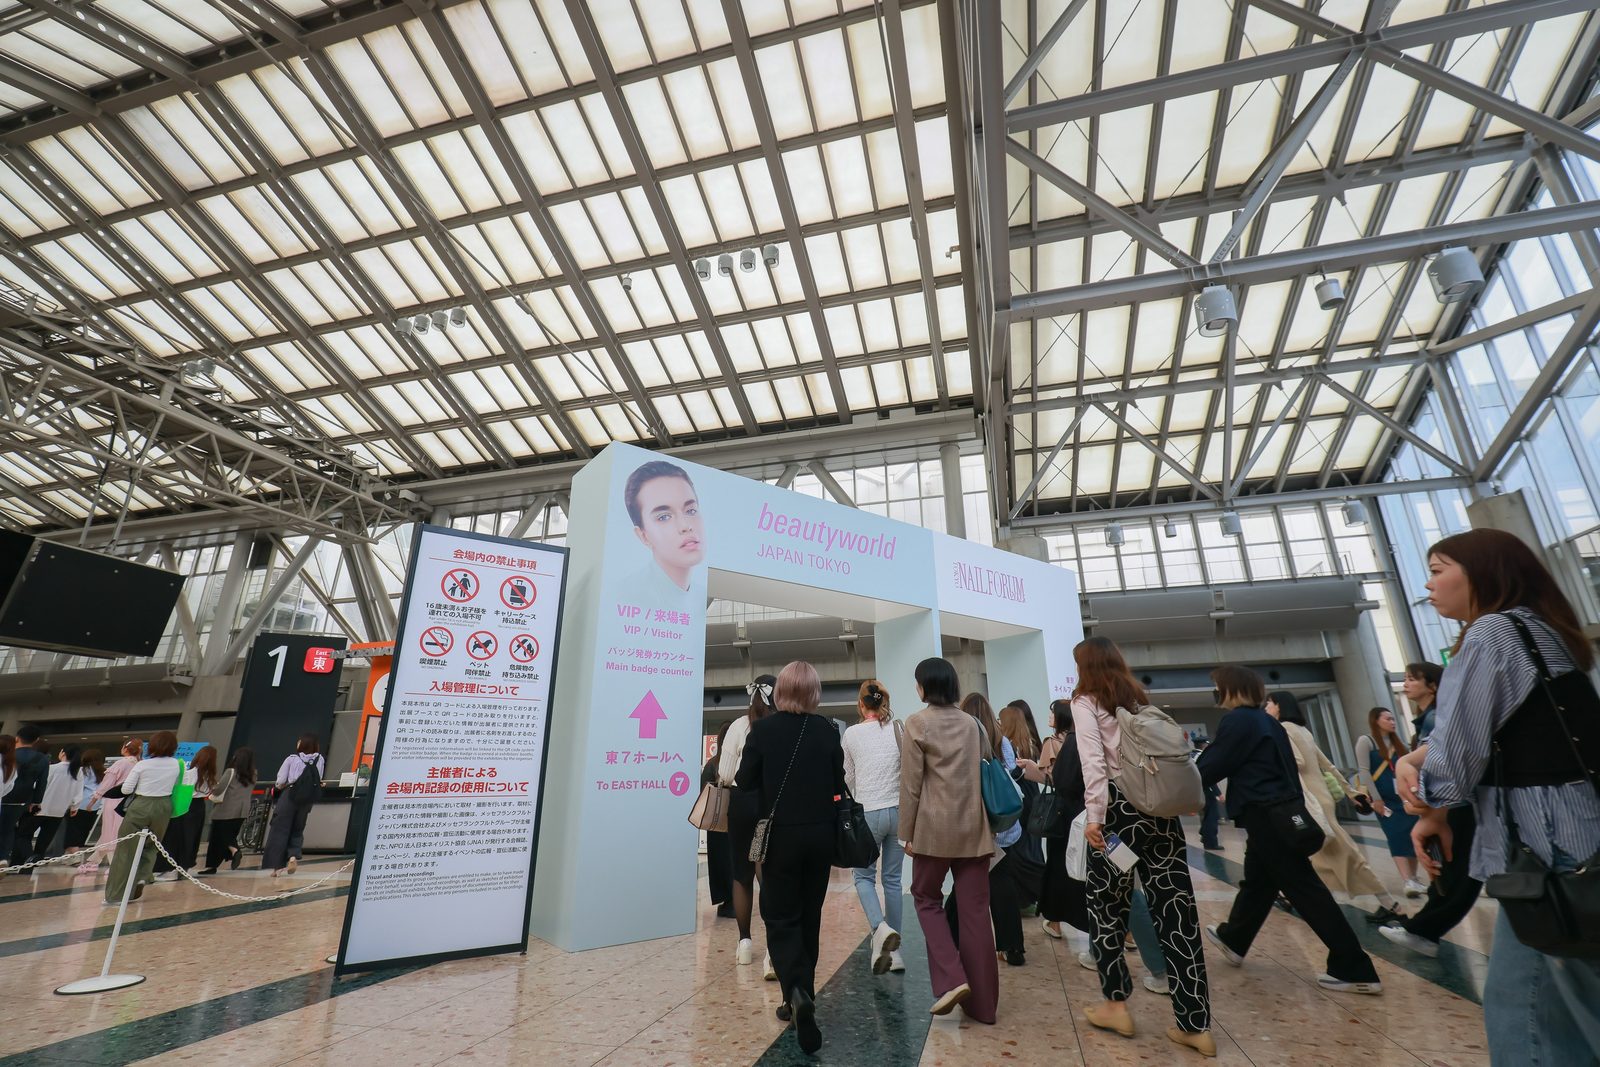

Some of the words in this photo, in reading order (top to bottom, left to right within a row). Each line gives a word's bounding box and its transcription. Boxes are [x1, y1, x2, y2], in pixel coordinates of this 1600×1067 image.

[757, 502, 896, 560] beautyworld
[453, 548, 537, 570] 会場内の禁止事項
[756, 544, 804, 565] JAPAN
[808, 553, 850, 574] TOKYO
[428, 609, 482, 620] 連れての入場不可
[494, 610, 537, 620] キャリーケース
[502, 617, 528, 626] 持込禁止
[617, 604, 641, 618] VIP
[645, 608, 652, 620] /
[654, 609, 690, 626] 来場者
[624, 624, 641, 636] VIP
[644, 626, 649, 636] /
[652, 628, 683, 640] Visitor
[608, 647, 694, 662] バッジ発券カウンター
[268, 645, 288, 687] 1
[312, 656, 327, 670] 東
[419, 658, 447, 667] 喫煙禁止
[509, 664, 534, 672] 危険物の
[606, 662, 629, 672] Main
[631, 664, 658, 675] badge
[660, 667, 693, 677] counter
[464, 669, 491, 677] 同伴禁止
[502, 672, 540, 680] 持ち込み禁止
[429, 680, 520, 696] 入場管理について
[606, 750, 685, 765] 東7ホールへ
[427, 766, 498, 779] 主催者による
[386, 781, 529, 795] 会場内記録の使用について
[596, 781, 609, 790] To
[612, 780, 639, 790] EAST
[641, 780, 667, 789] HALL
[675, 778, 685, 792] 7
